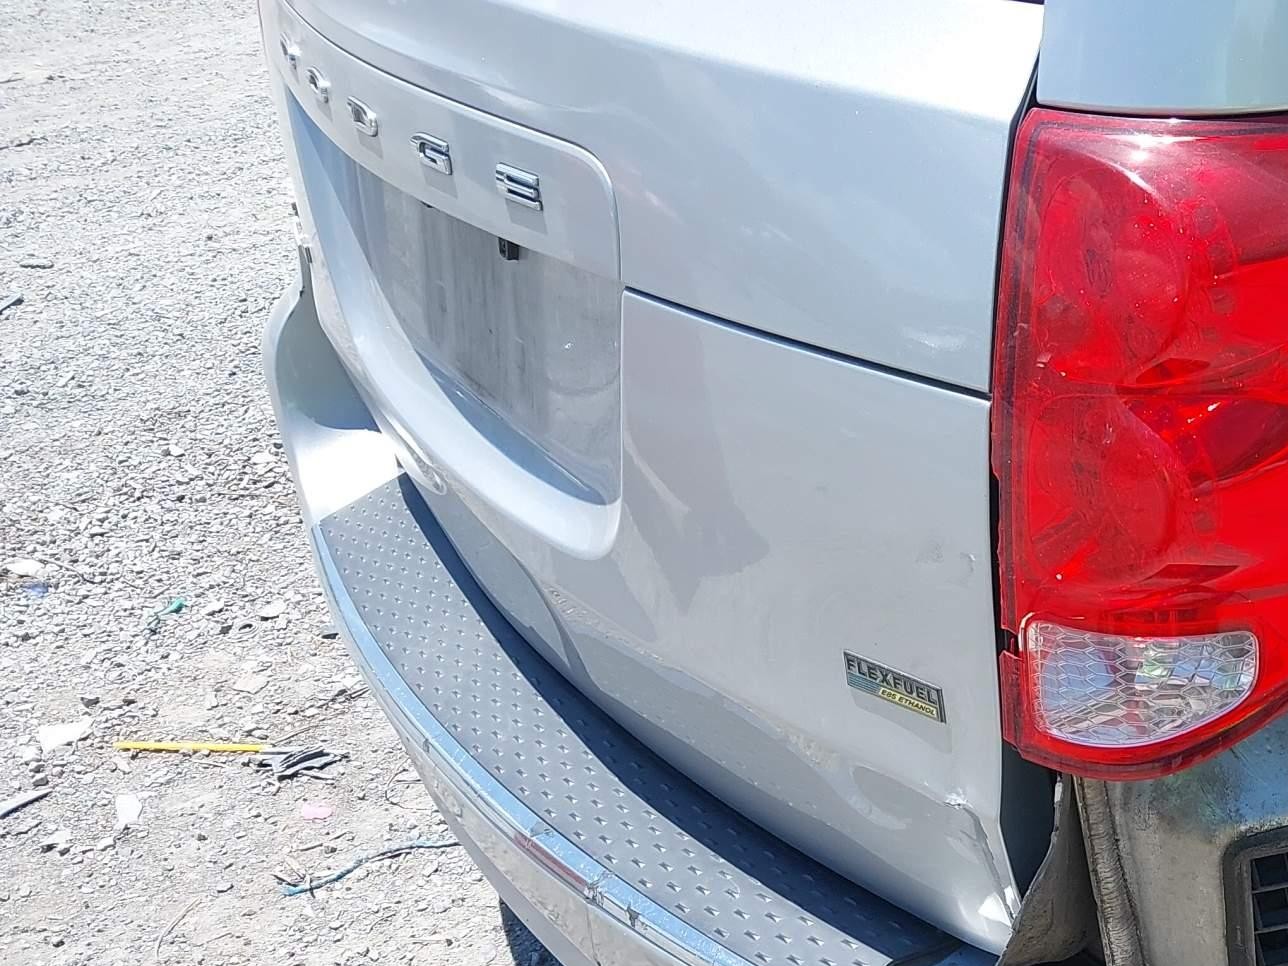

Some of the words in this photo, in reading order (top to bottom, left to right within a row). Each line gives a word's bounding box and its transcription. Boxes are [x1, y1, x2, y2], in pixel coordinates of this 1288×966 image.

[279, 31, 543, 211] DODGE
[845, 658, 938, 705] FLEXFUEL
[880, 688, 897, 701] E85
[898, 695, 936, 716] ETHANOL
